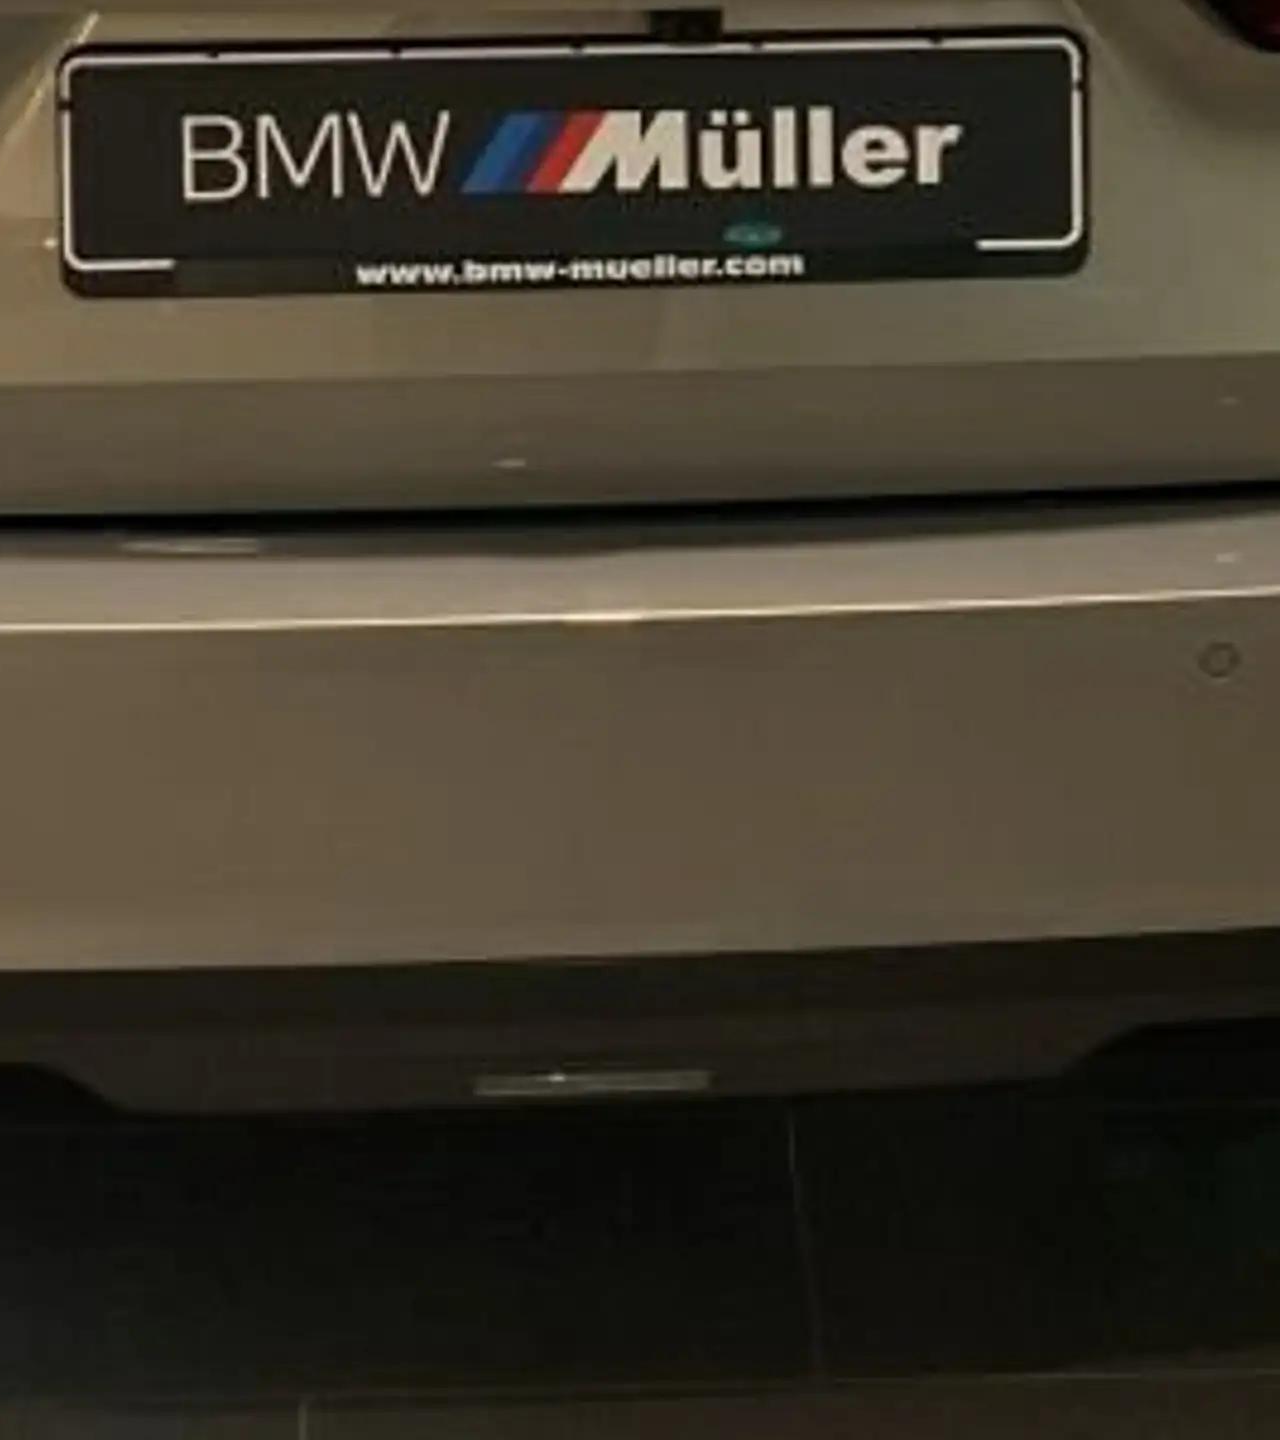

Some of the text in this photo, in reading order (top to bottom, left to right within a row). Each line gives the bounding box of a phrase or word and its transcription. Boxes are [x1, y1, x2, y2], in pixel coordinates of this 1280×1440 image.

[181, 109, 962, 200] BMW Müller
[356, 254, 805, 286] www.bmw-mueller.com
